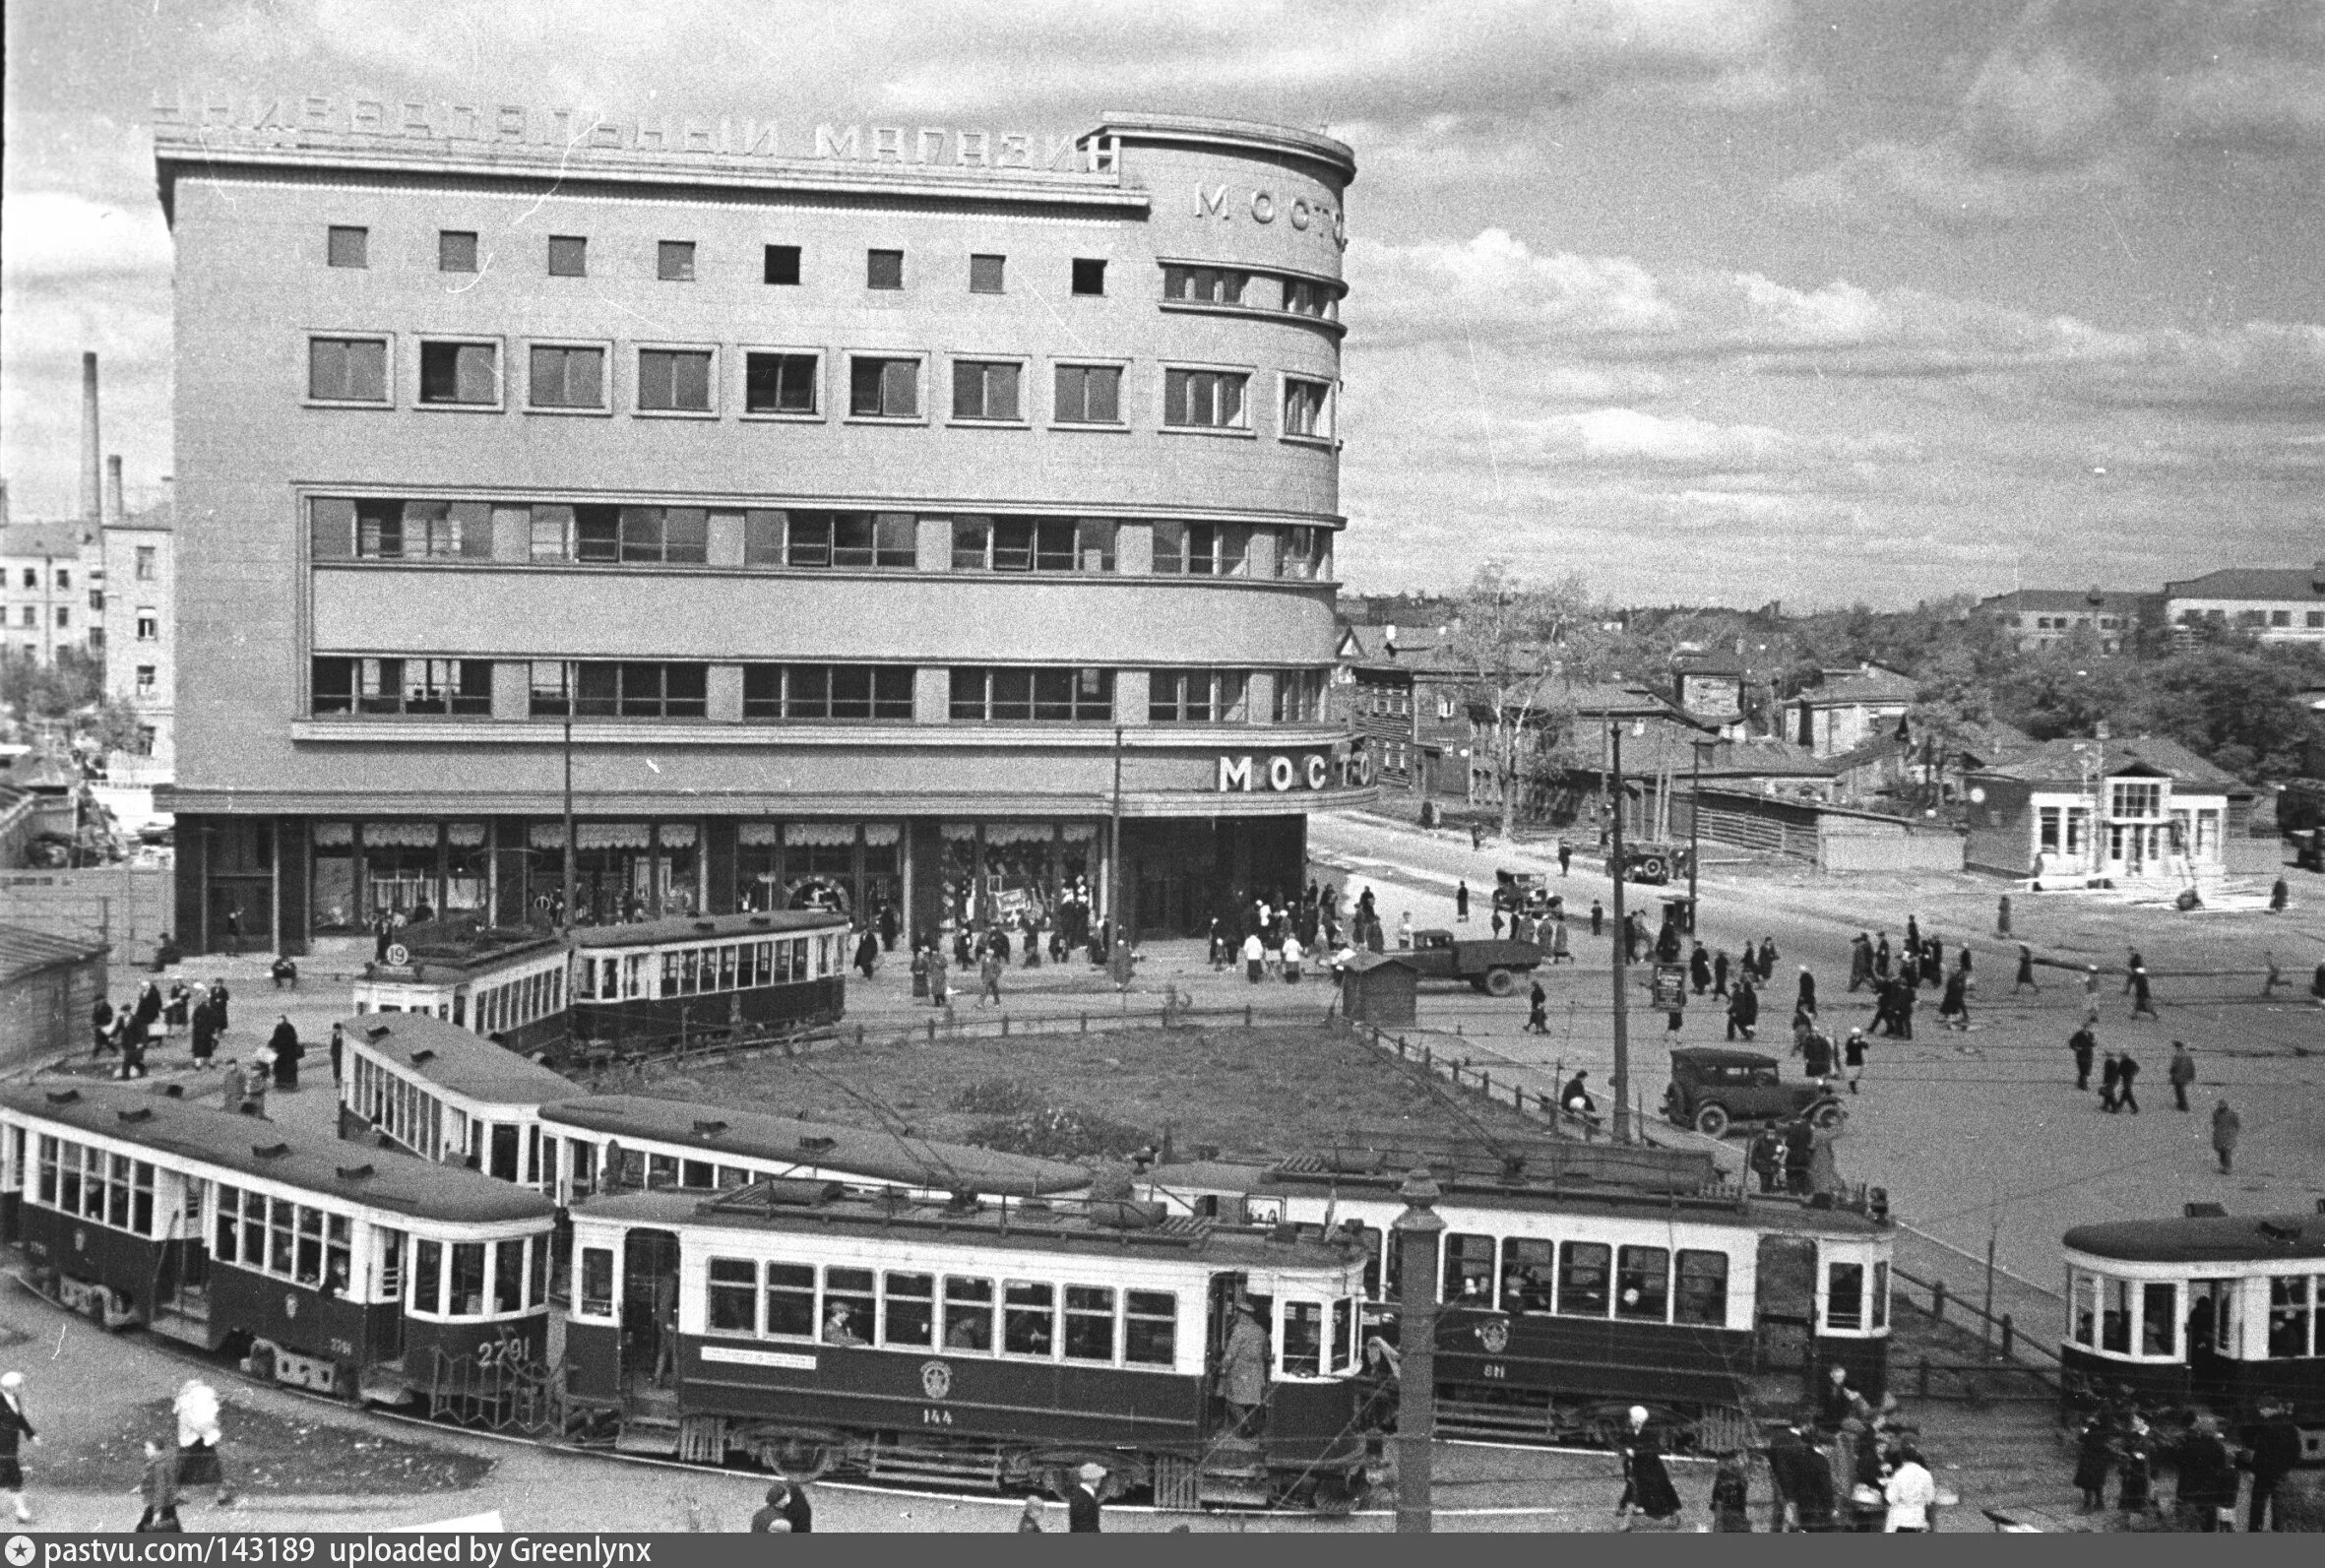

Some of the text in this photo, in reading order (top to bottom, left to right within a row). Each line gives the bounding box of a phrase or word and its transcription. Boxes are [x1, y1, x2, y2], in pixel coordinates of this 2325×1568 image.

[815, 121, 1121, 173] МАГАЗИН
[477, 1336, 530, 1367] 2791
[923, 1409, 953, 1425] 144
